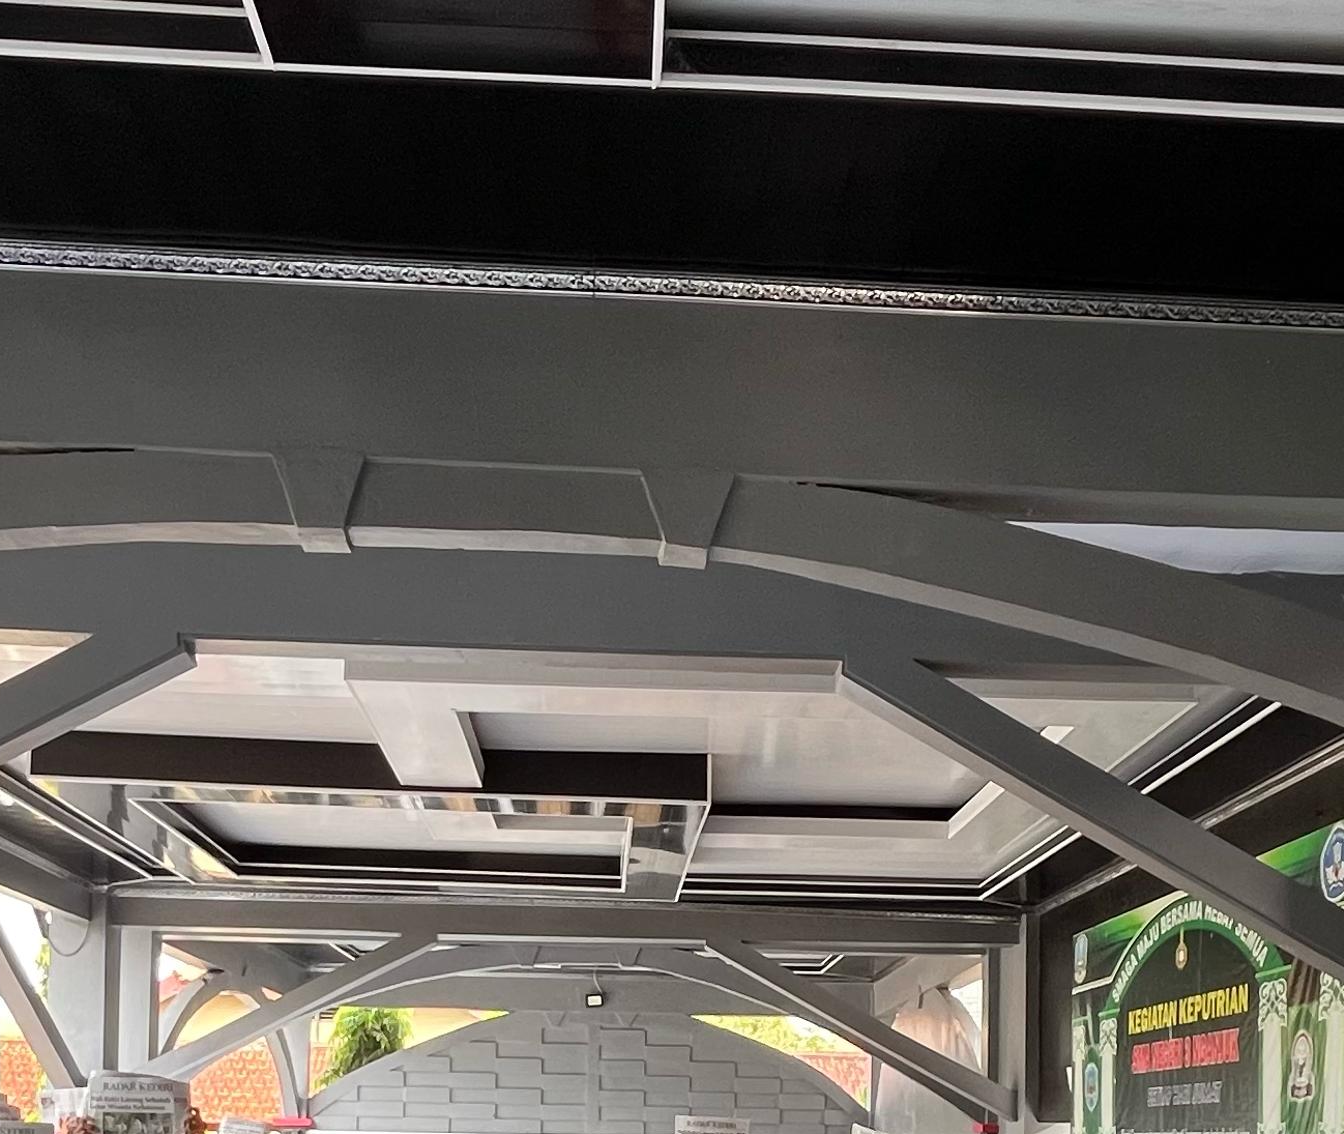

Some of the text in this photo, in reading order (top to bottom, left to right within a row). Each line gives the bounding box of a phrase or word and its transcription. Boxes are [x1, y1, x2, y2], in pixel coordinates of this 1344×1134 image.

[1112, 954, 1138, 1002] SMAGA
[1137, 922, 1160, 960] MAJU
[1160, 900, 1203, 932] BERSAMA
[1128, 984, 1248, 1035] KEGIATAN KEPUTRIAN
[103, 1082, 173, 1092] RADAR KEDIRI
